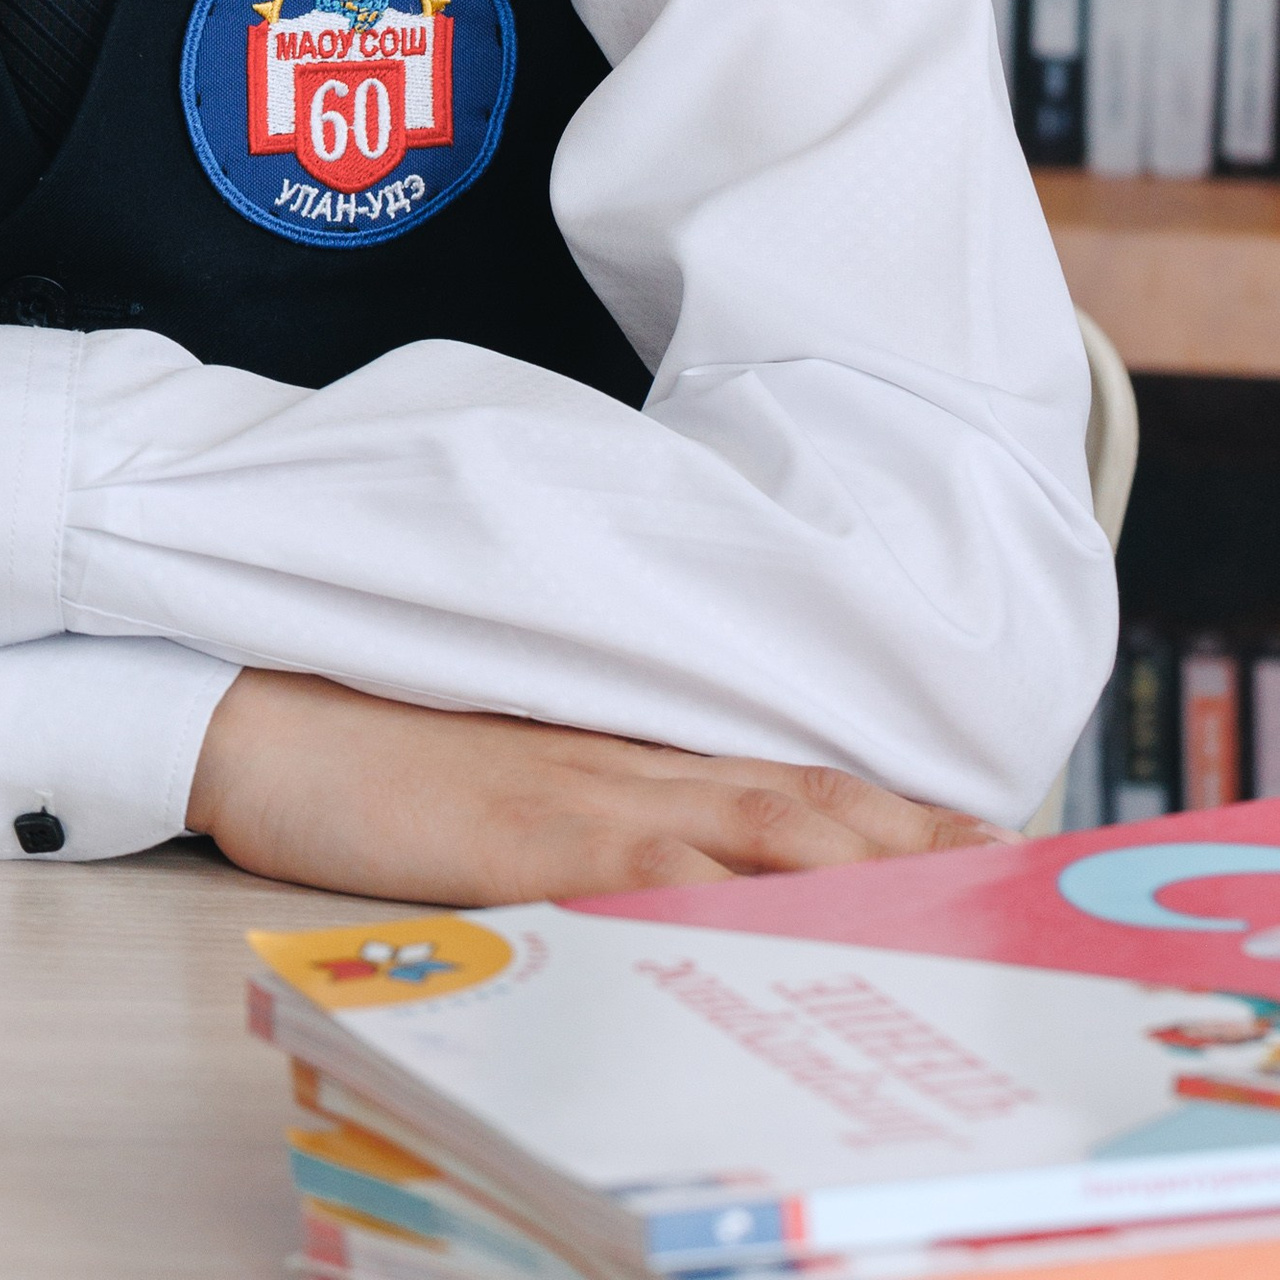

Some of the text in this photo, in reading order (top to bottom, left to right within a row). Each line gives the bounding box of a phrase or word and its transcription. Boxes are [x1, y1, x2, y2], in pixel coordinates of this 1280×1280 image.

[275, 25, 428, 61] МАОУ СОШ
[310, 77, 392, 163] 60
[274, 173, 426, 224] УЛАН-УДЭ
